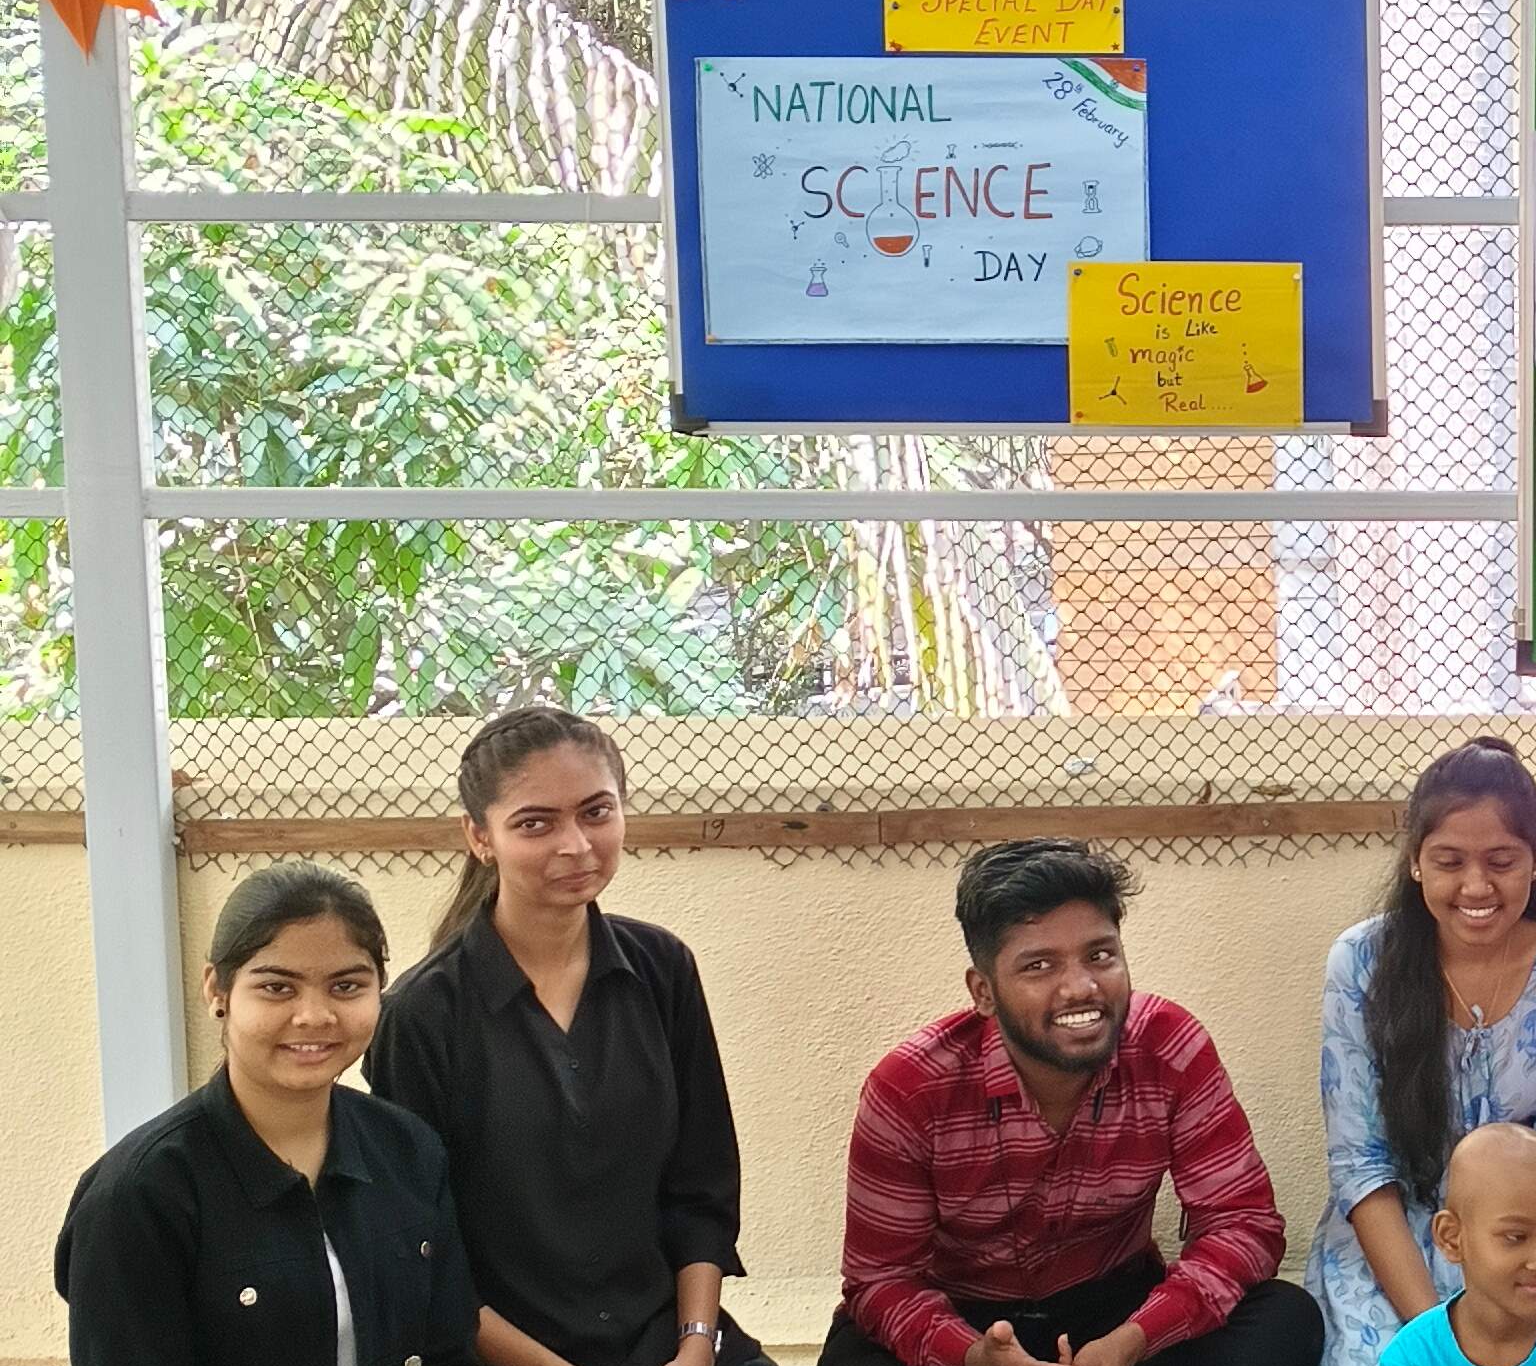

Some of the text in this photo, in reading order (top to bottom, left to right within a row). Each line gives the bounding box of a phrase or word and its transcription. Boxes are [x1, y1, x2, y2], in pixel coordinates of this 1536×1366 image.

[974, 18, 1074, 45] EVENT
[753, 81, 952, 124] NATIONAL
[1072, 98, 1128, 149] February
[973, 250, 1047, 282] DAY
[1118, 272, 1243, 316] Science
[1185, 319, 1218, 337] Like
[1130, 346, 1195, 373] magic
[1157, 371, 1183, 387] but
